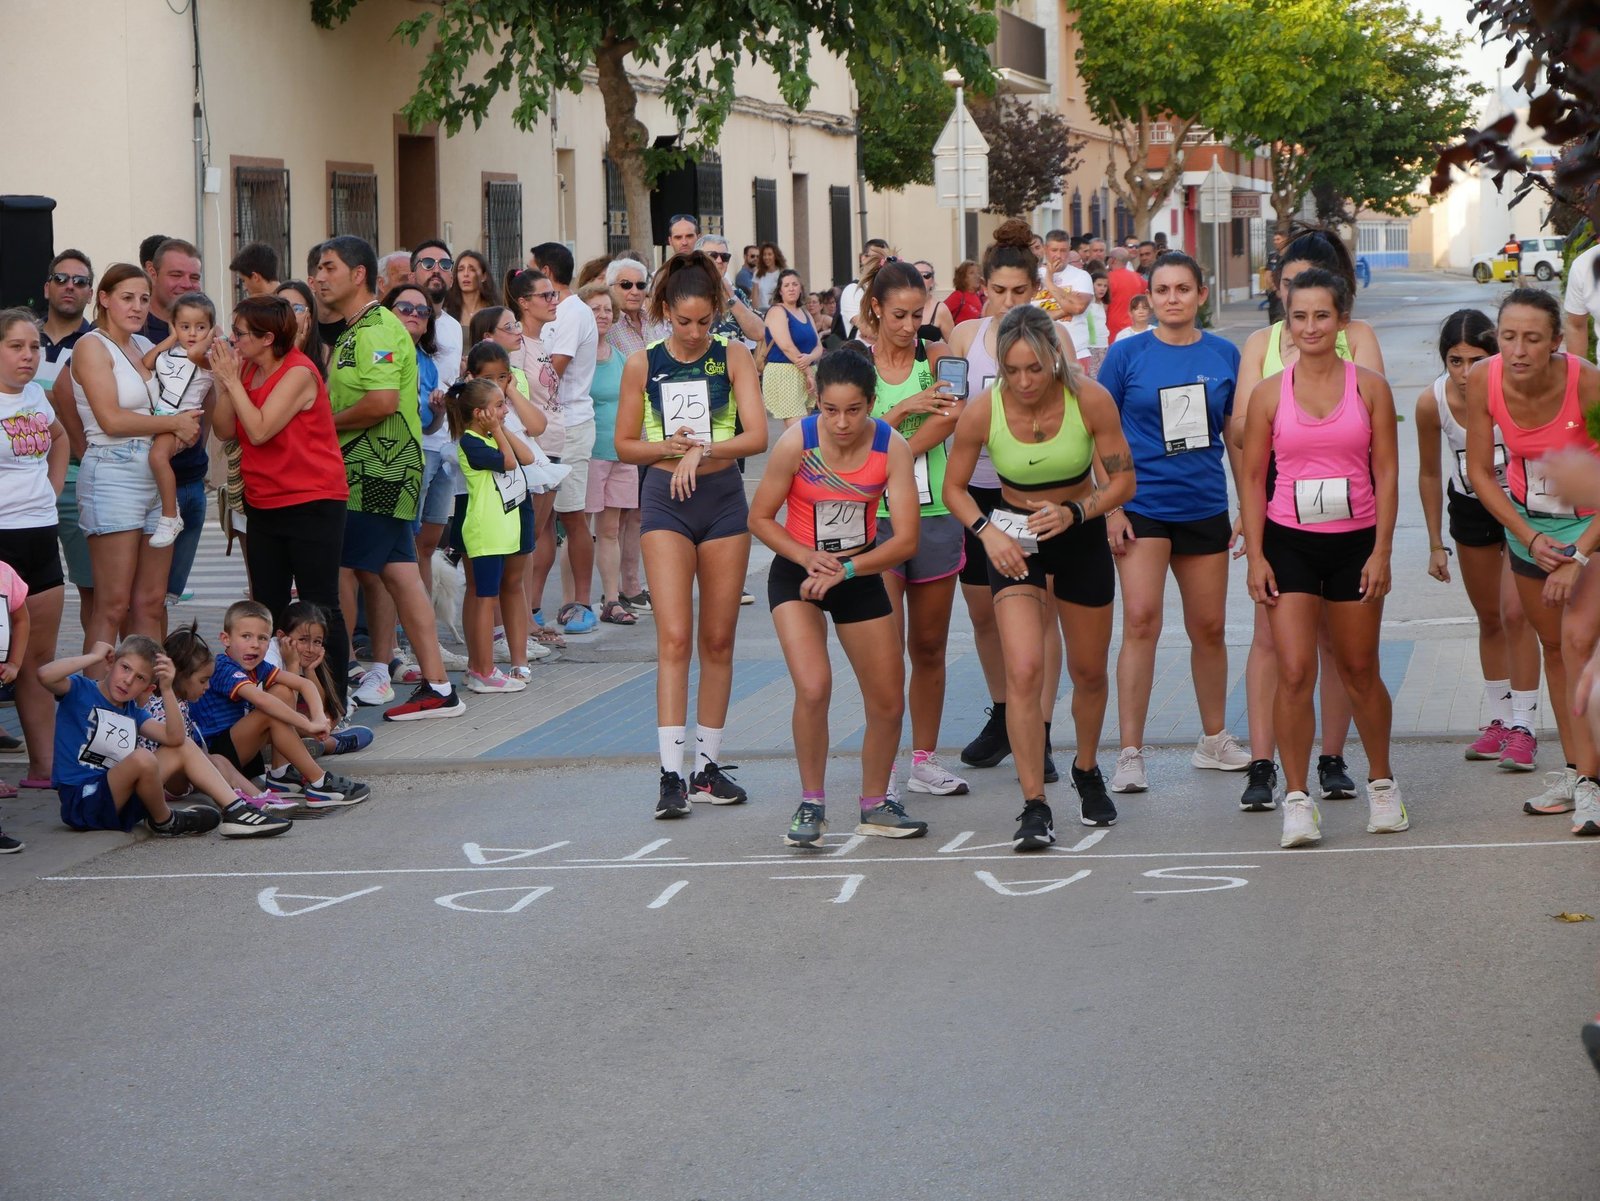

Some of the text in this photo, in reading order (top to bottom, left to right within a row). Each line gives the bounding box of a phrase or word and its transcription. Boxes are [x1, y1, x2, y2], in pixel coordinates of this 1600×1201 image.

[160, 360, 186, 380] 31
[670, 393, 706, 421] 25
[1174, 394, 1198, 428] 2
[1312, 480, 1330, 515] 1
[824, 501, 858, 526] 20
[105, 721, 130, 749] 78
[257, 864, 1262, 917] SALIDA
